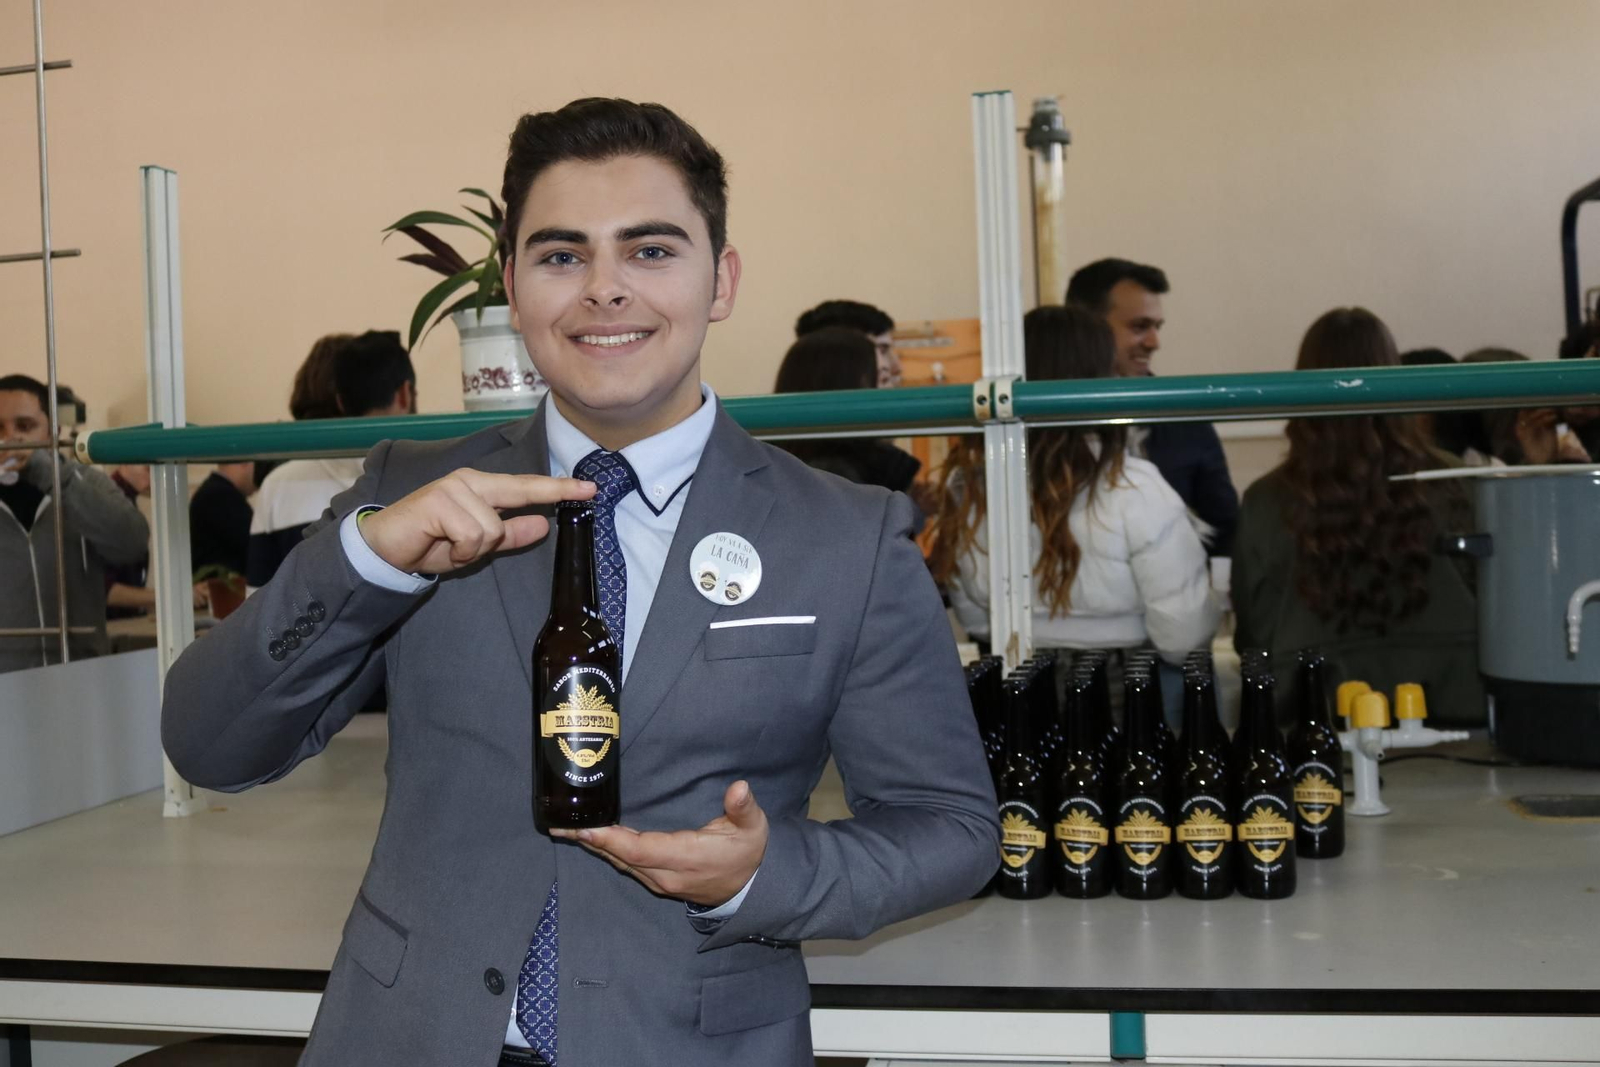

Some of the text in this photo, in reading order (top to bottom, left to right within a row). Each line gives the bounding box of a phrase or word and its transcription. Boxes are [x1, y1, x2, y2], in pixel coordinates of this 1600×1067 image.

[711, 544, 749, 569] LA CAÑA
[553, 672, 572, 692] SABOR
[555, 715, 614, 729] MAESTRIA
[564, 771, 604, 783] SINCE 1971
